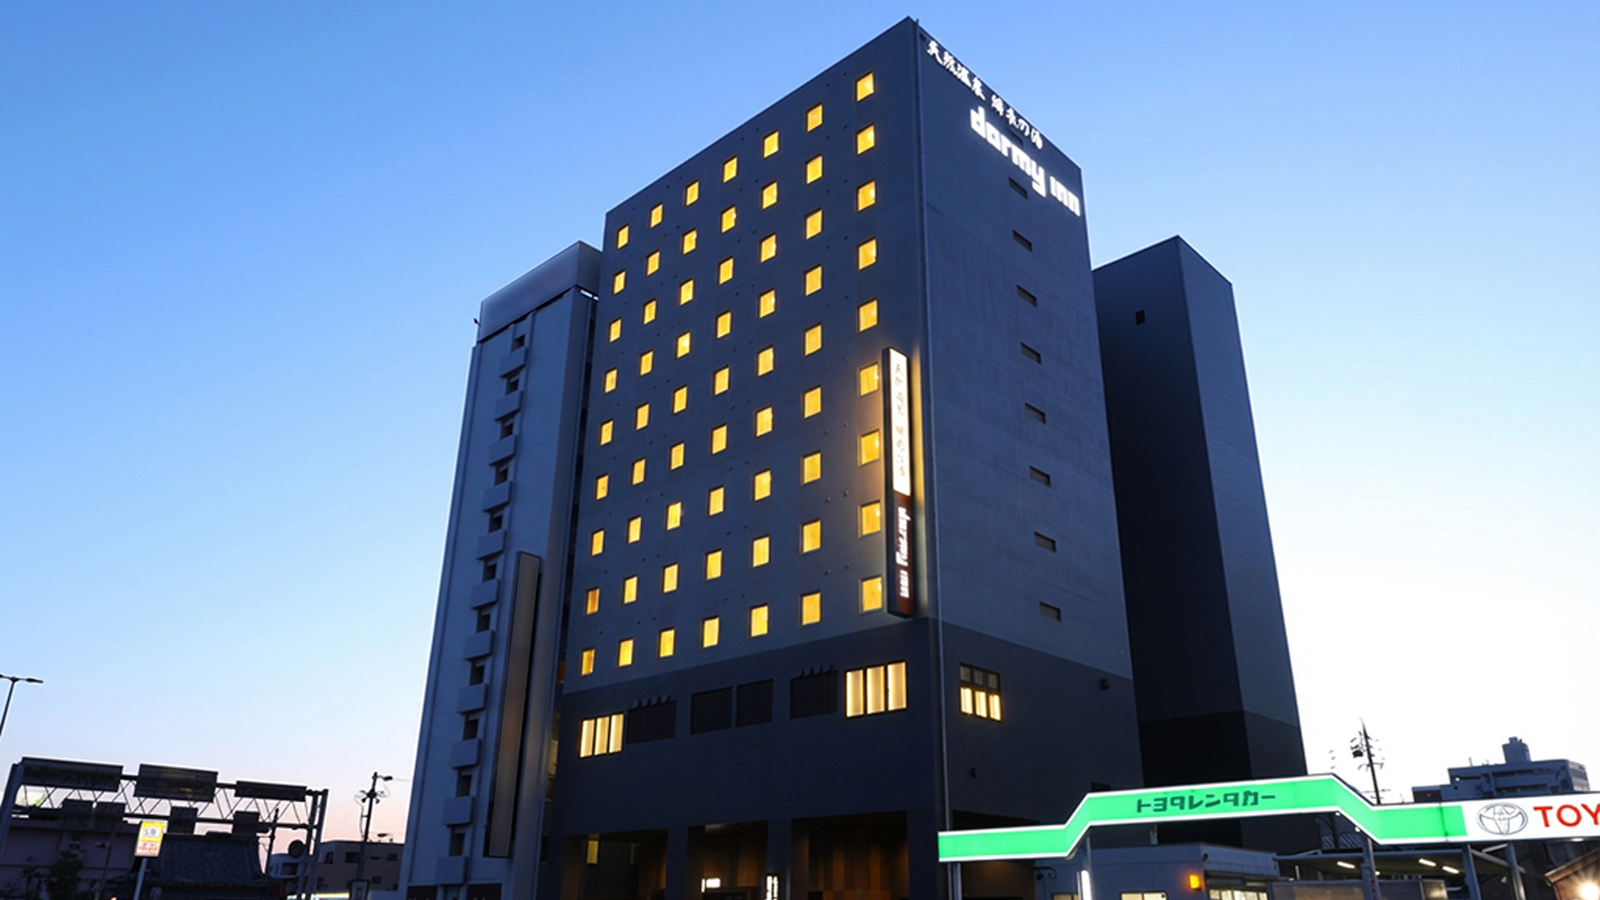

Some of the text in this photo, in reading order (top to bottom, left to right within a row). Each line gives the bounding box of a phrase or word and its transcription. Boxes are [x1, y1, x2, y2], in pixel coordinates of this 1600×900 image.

[970, 105, 1081, 217] dormy inn
[1136, 790, 1276, 813] トヨタレンタカー
